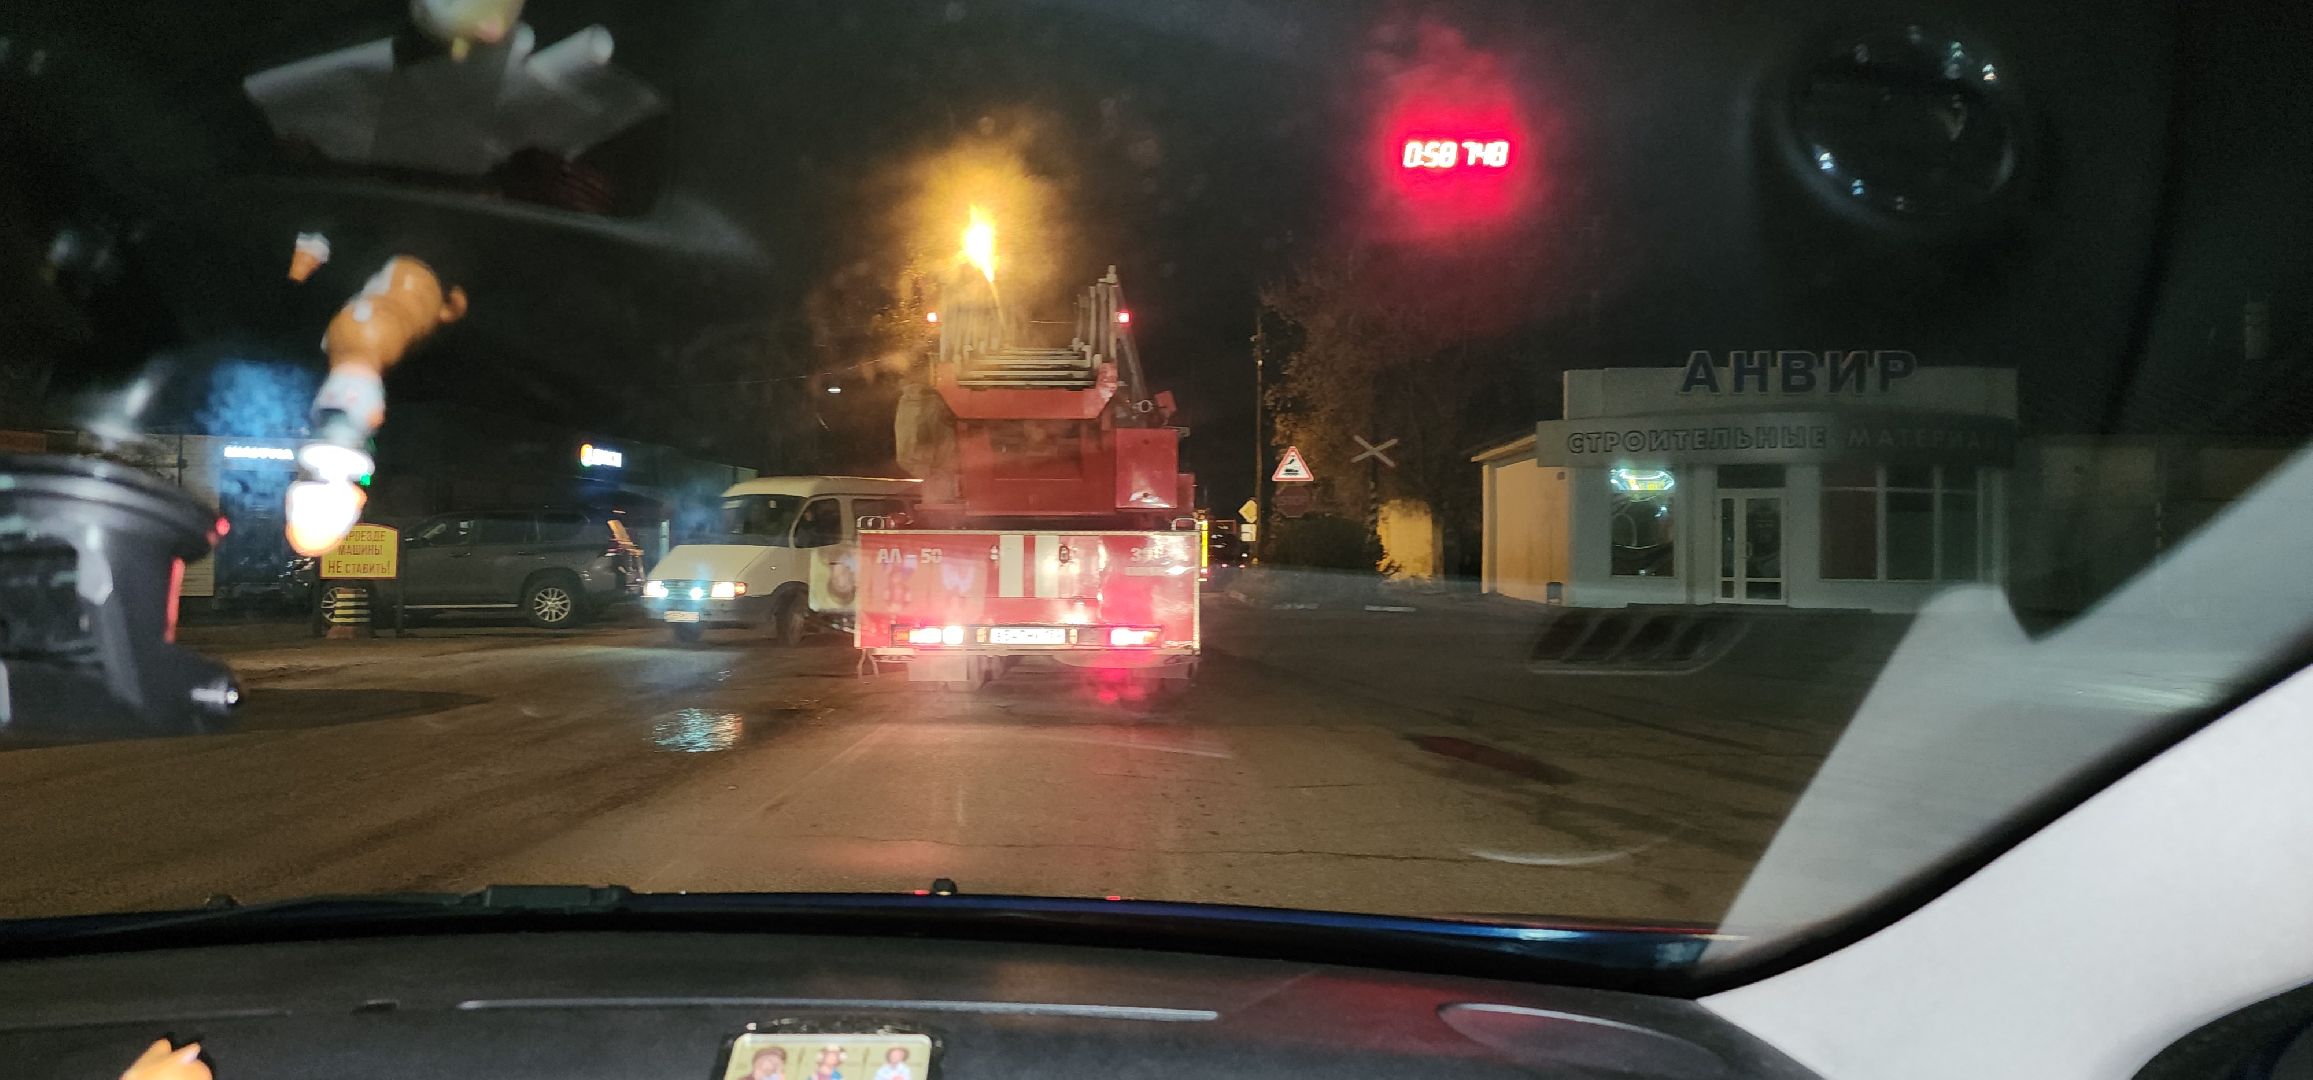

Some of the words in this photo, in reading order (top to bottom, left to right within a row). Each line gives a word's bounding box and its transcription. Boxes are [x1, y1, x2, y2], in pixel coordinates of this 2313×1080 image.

[1678, 350, 1918, 396] АНВИР
[1566, 426, 1827, 454] СТРОИТЕЛЬНЫЕ
[337, 544, 383, 556] МАШИНЫ
[920, 547, 943, 564] 50
[328, 560, 343, 574] НЕ
